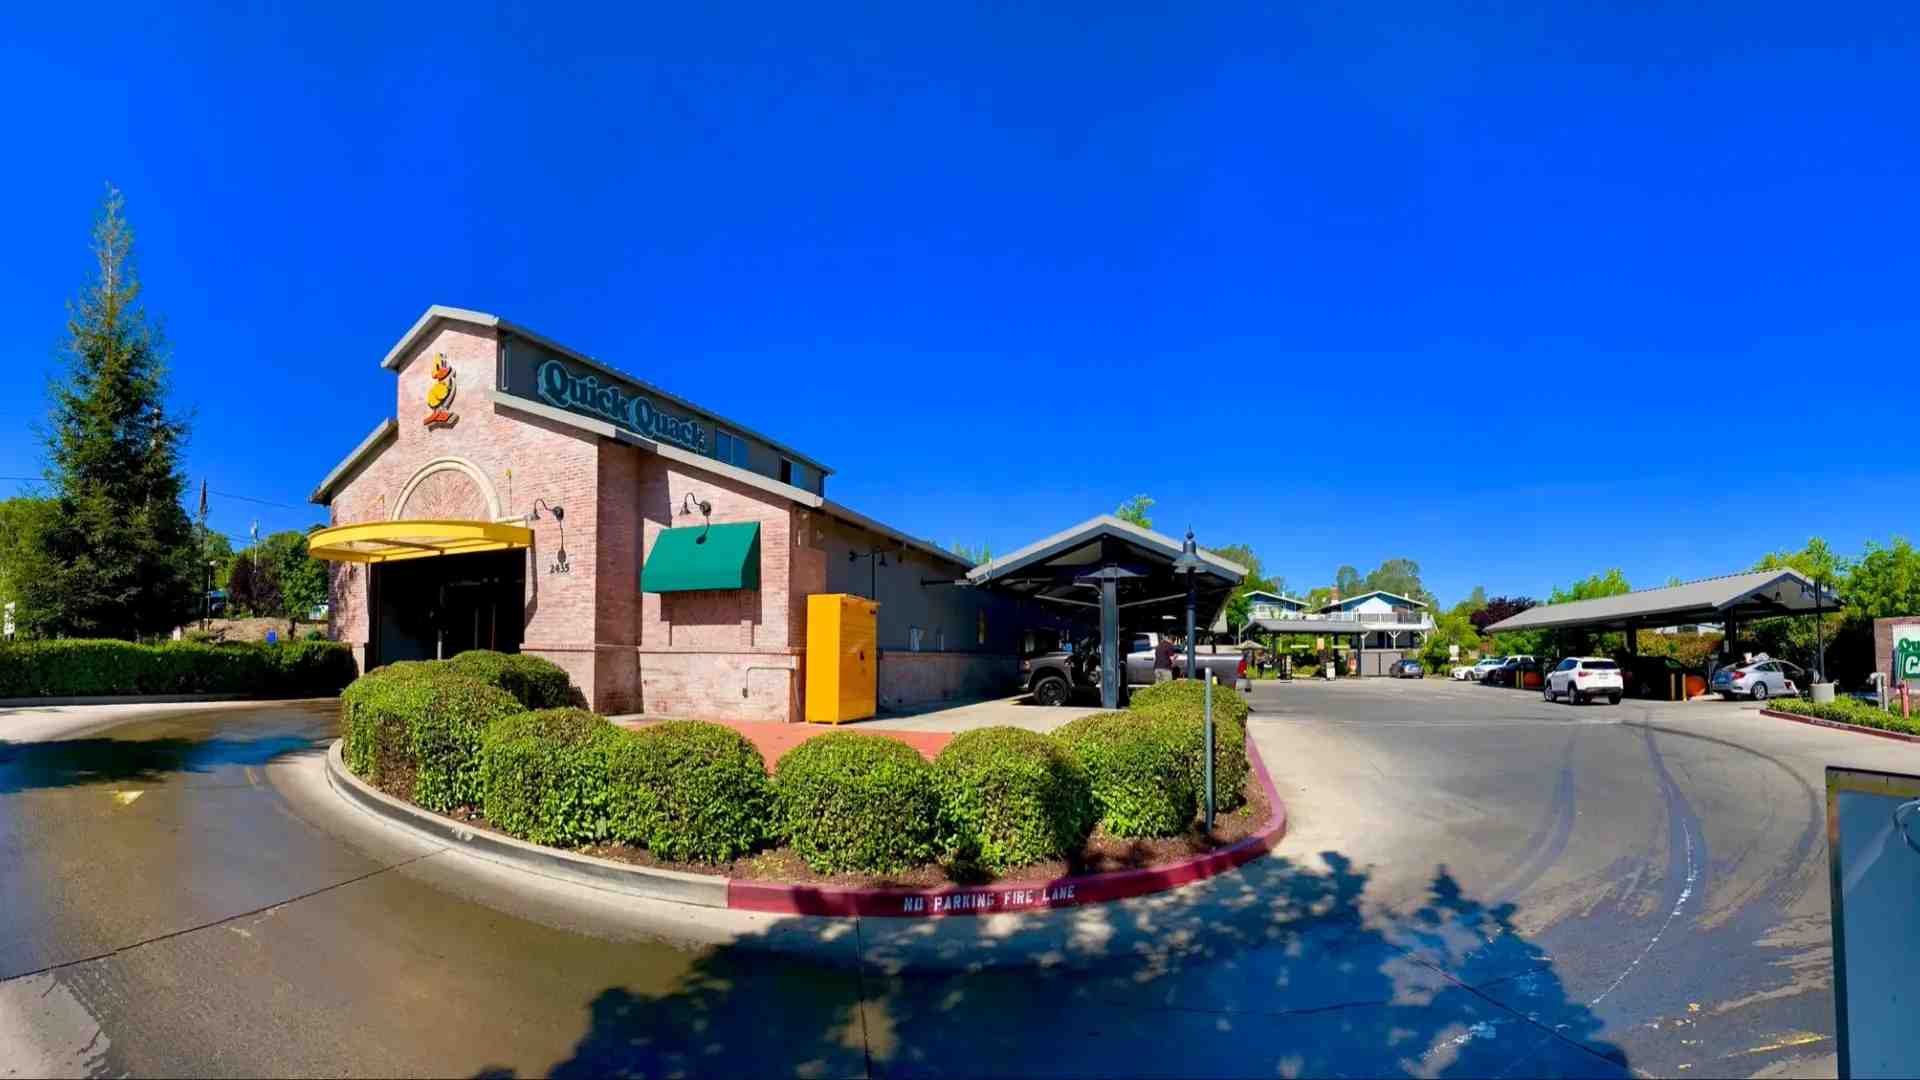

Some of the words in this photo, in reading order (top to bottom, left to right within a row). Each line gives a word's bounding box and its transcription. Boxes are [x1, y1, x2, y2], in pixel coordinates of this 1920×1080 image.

[537, 360, 628, 420] Quick
[628, 393, 705, 454] Quack
[1905, 655, 1920, 674] C
[903, 896, 924, 913] NO
[933, 893, 995, 912] PARKING
[1004, 889, 1034, 905] FIRE
[1042, 885, 1076, 902] LANE
